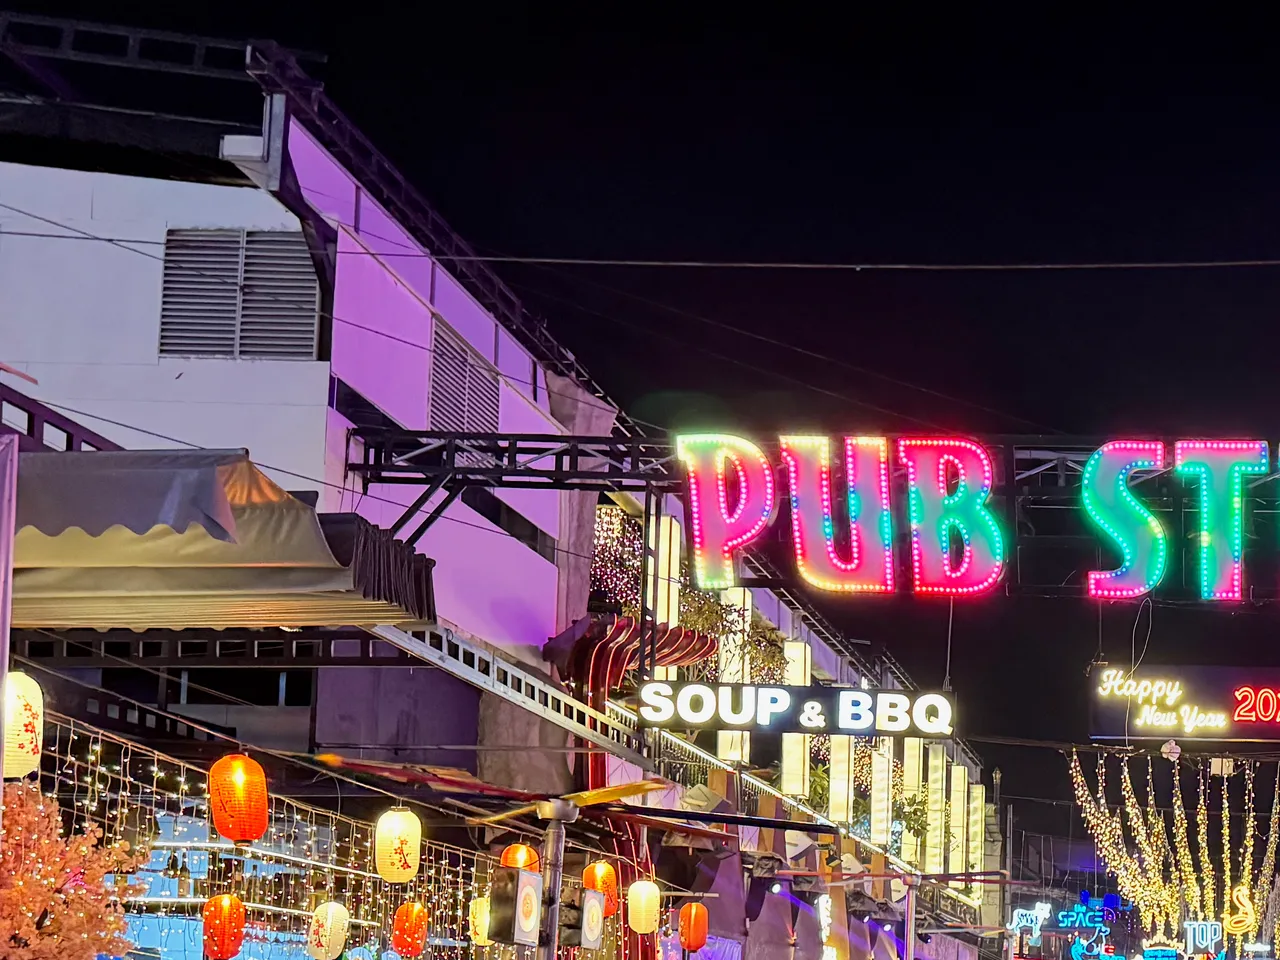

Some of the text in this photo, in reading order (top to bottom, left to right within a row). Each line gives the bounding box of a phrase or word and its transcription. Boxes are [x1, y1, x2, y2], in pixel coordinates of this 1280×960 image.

[676, 433, 1008, 597] PUB
[1098, 669, 1183, 706] Happy
[639, 682, 954, 735] SOUP & BBQ
[1135, 703, 1227, 733] New Year
[1058, 910, 1104, 928] SPACE
[1183, 920, 1223, 955] TOP
